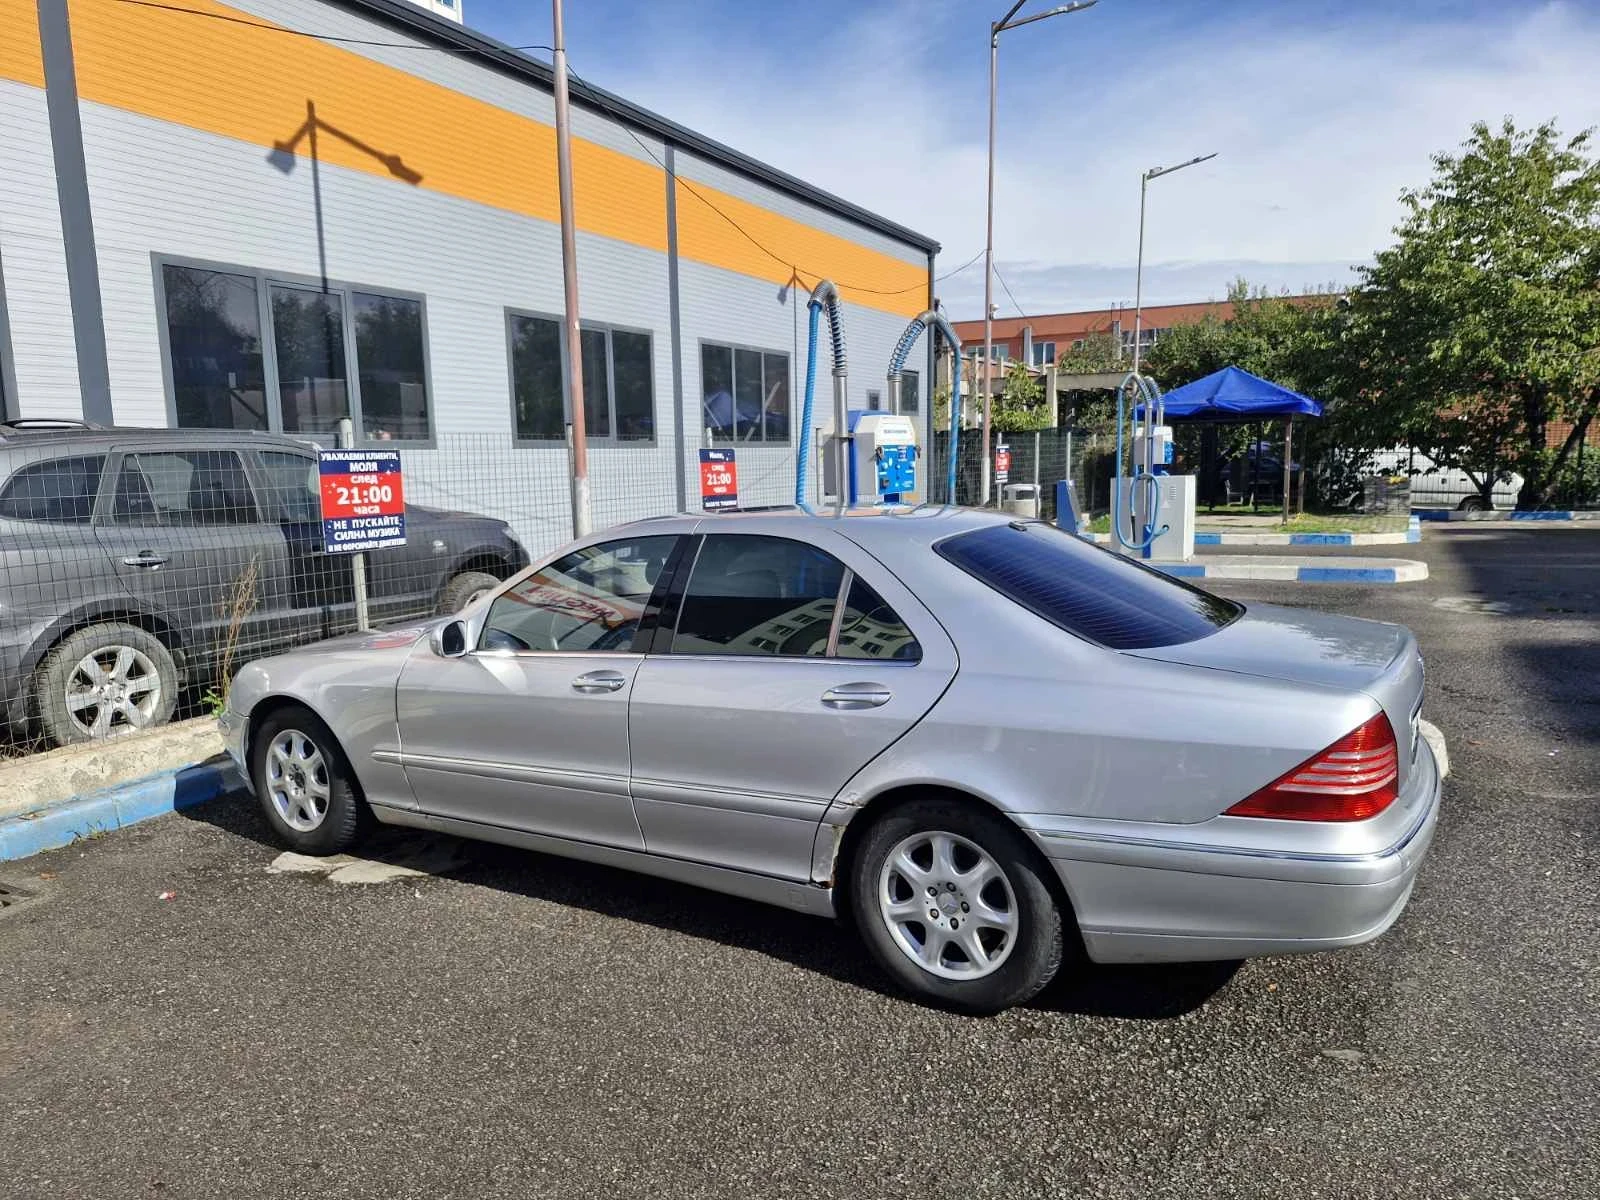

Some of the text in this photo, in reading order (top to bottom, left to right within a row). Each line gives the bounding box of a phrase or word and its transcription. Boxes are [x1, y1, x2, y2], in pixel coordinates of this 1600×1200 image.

[320, 452, 364, 461] УВАЖАЕМИ
[349, 462, 378, 472] МОЛЯ
[350, 474, 378, 484] след
[706, 473, 732, 485] 21:00
[336, 485, 392, 505] 21:00
[353, 504, 380, 514] часа
[333, 520, 348, 530] НЕ
[334, 527, 400, 541] СИЛНА МУЗИКА
